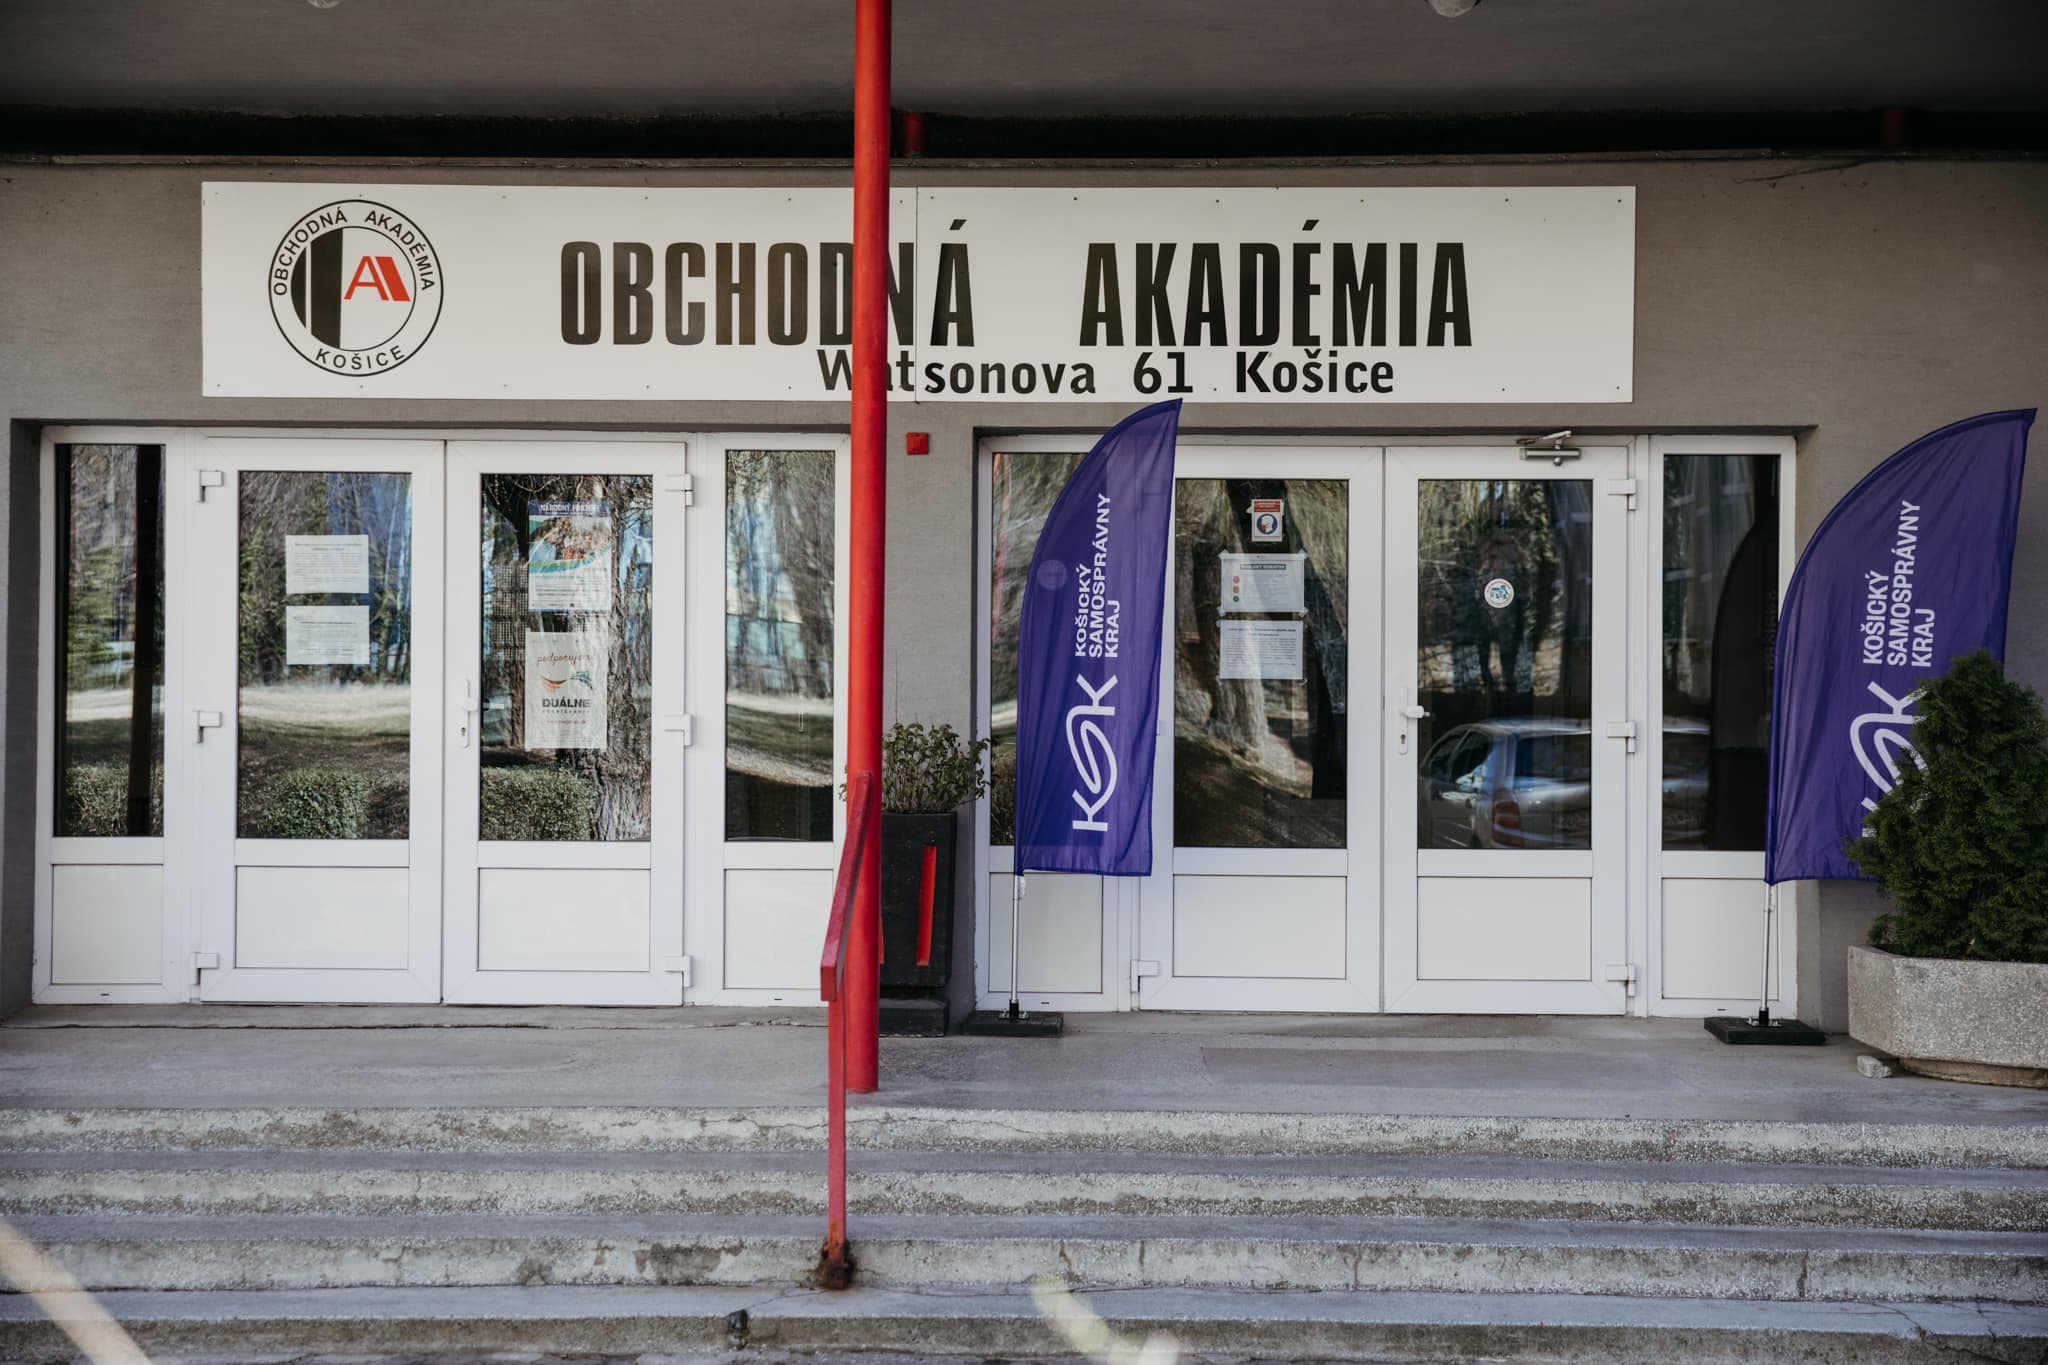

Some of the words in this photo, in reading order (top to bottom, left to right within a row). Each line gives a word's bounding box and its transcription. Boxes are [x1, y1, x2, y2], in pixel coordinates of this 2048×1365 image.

[273, 206, 348, 296] OBCHODNÁ
[364, 210, 435, 291] AKADÉMIA
[560, 219, 975, 347] OBCHODNÁ
[1079, 219, 1473, 347] AKADÉMIA
[315, 345, 405, 370] KOŠICE
[816, 348, 1097, 394] Wtsonova
[1132, 351, 1194, 394] 61
[1235, 348, 1394, 394] Košice
[1075, 563, 1092, 657] KOŠICKÝ
[1089, 493, 1112, 658] SAMOSPRÁVNY
[1860, 569, 1890, 665] KOŠICKÝ
[1887, 500, 1921, 667] SAMOSPRÁVNY
[1105, 599, 1121, 658] KRAJ
[1911, 608, 1936, 668] KRAJ
[541, 695, 592, 708] DUÁLNE
